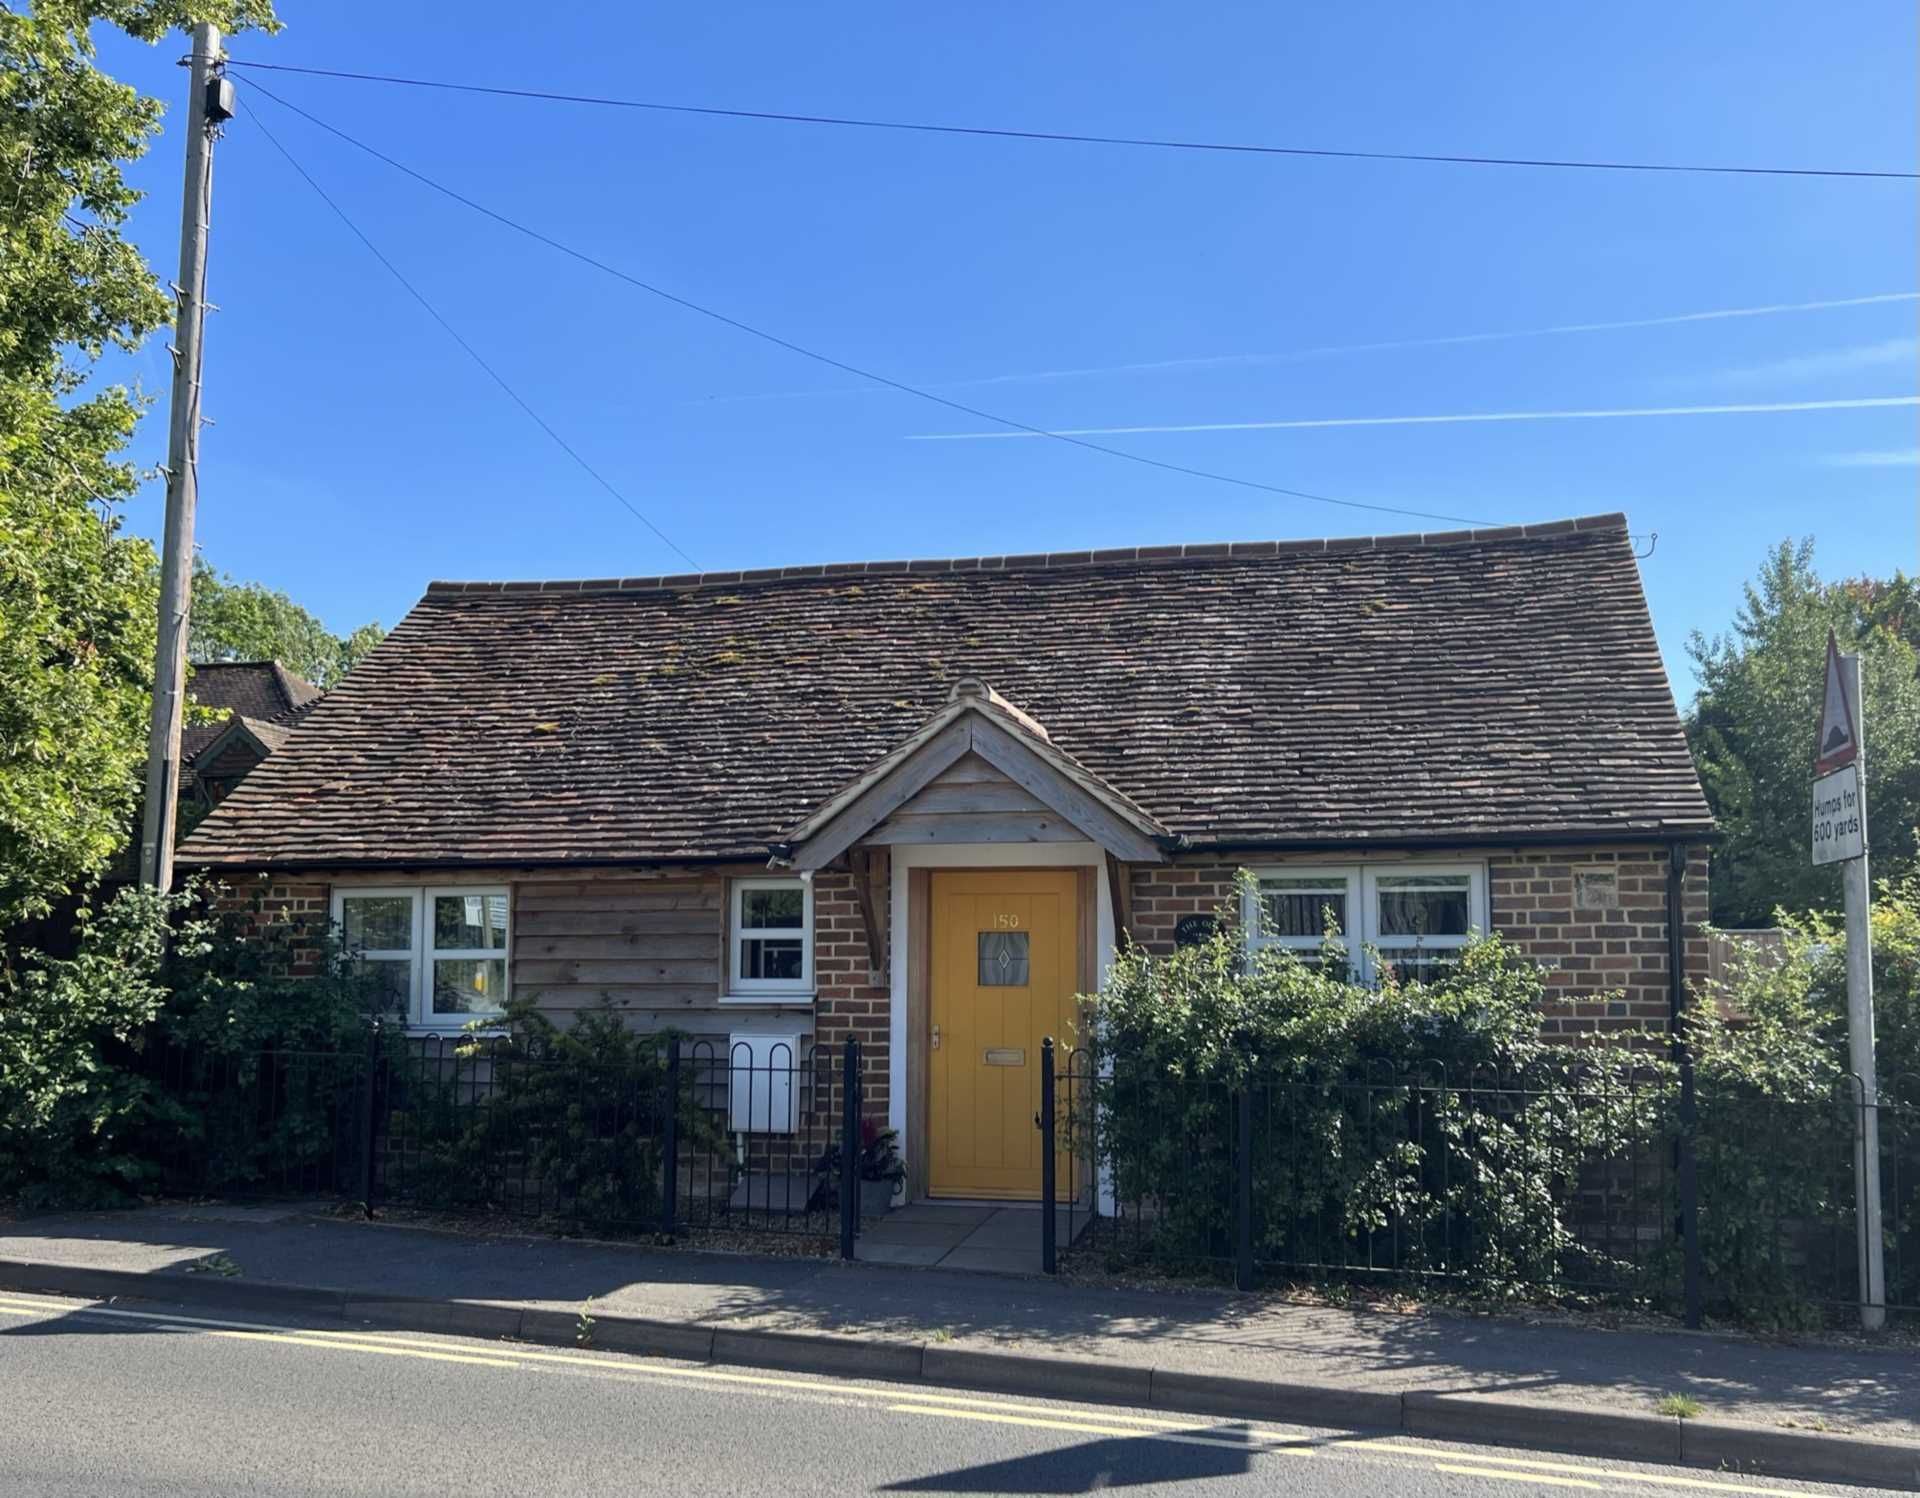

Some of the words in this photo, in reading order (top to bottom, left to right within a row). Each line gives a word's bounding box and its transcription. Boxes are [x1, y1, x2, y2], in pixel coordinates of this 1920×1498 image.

[1814, 797, 1841, 818] Humps
[1843, 789, 1856, 809] for
[1814, 820, 1831, 842] 600
[1834, 815, 1859, 842] yards
[993, 912, 1019, 929] 150
